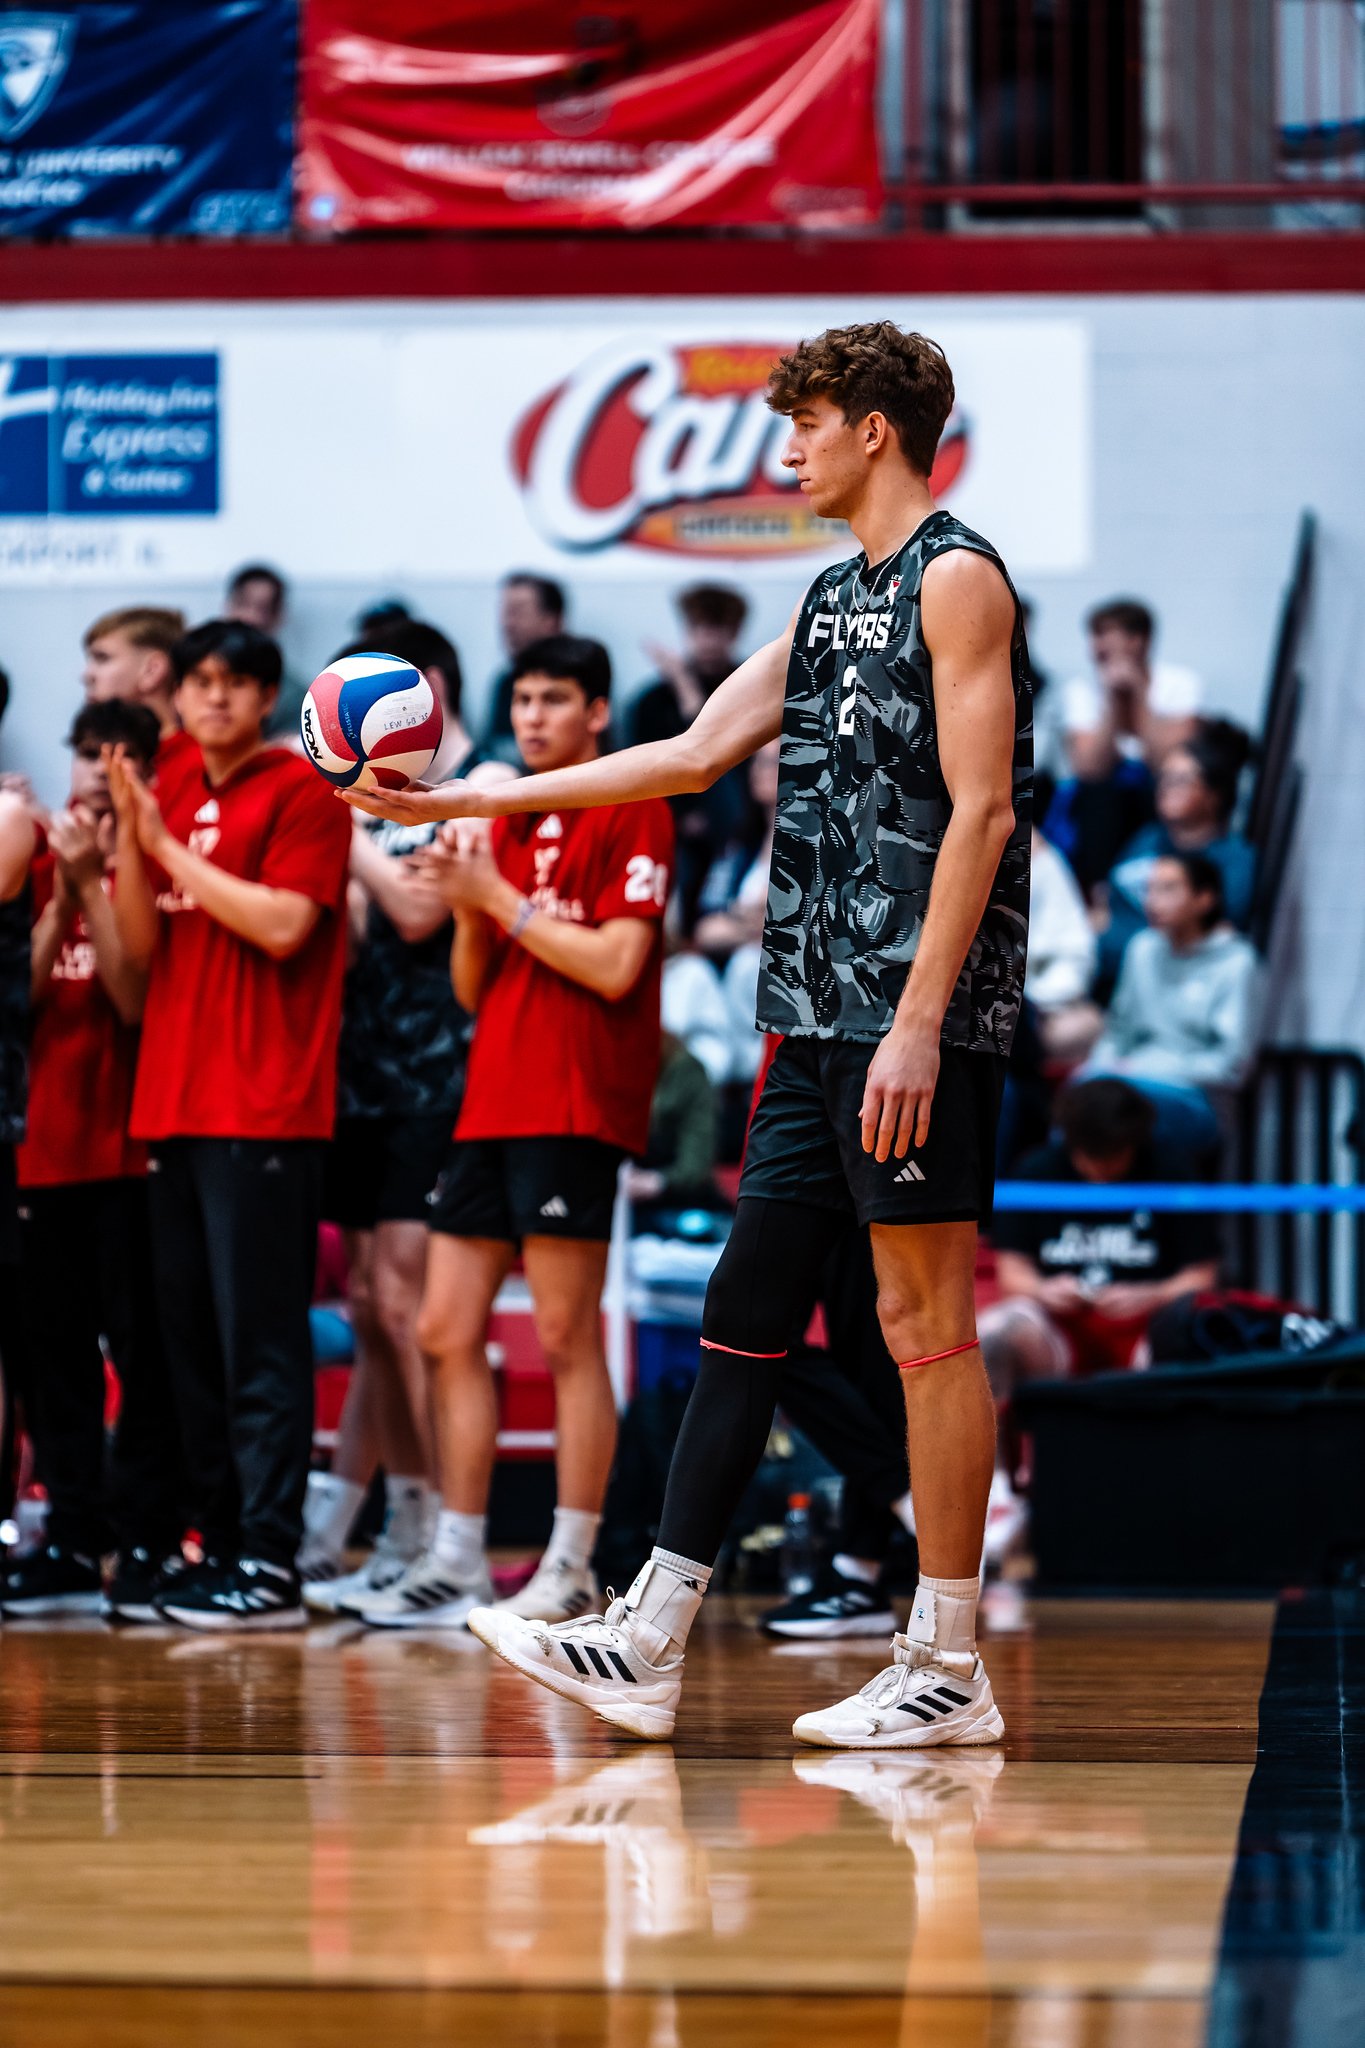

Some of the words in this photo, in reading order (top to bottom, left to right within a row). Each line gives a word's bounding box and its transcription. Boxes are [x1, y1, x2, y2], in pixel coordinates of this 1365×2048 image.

[62, 416, 209, 463] Express
[838, 665, 858, 736] 2
[304, 708, 323, 760] NCAA
